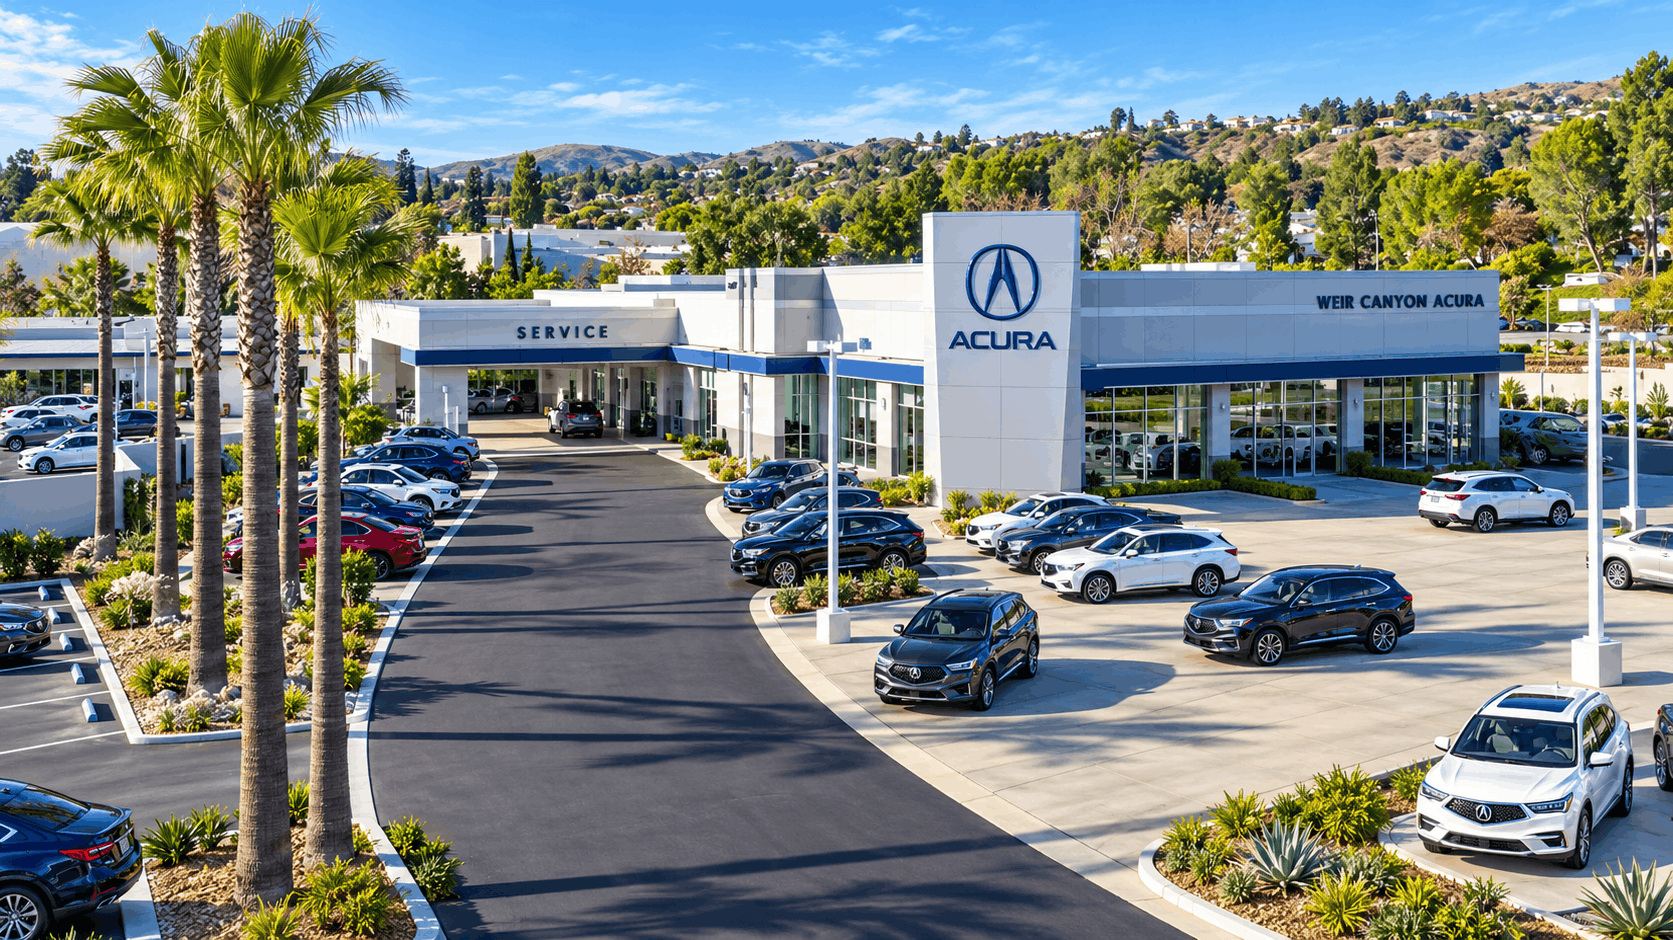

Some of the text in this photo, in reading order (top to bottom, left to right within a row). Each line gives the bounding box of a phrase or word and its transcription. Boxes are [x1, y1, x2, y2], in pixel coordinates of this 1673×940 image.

[1316, 293, 1485, 310] WEIR CANYON ACURA
[516, 324, 608, 340] SERVICE
[948, 330, 1057, 351] ACURA
